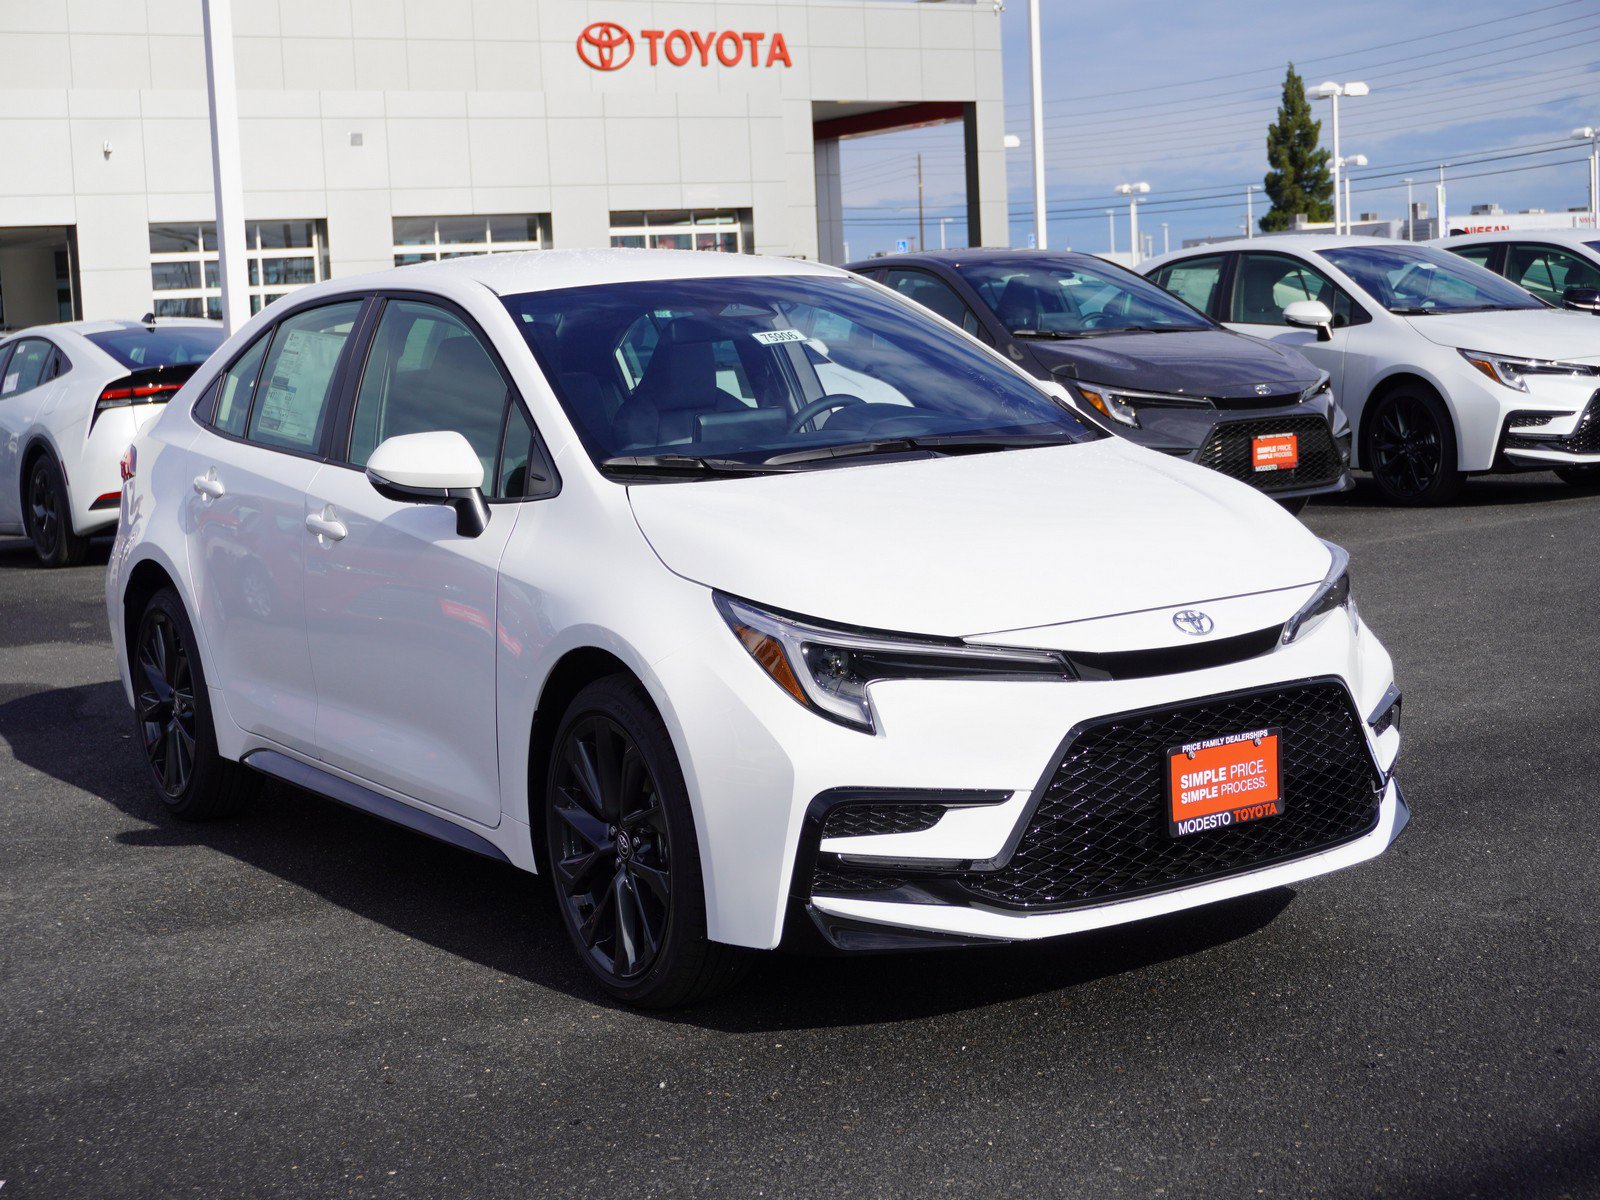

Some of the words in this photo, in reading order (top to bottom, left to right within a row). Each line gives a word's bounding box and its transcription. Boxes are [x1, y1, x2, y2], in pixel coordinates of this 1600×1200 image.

[641, 29, 792, 67] TOYOTA
[760, 331, 799, 342] 75906
[1182, 742, 1201, 753] PRICE
[1202, 738, 1225, 748] FAMILY
[1225, 729, 1268, 744] DEALERSHIPS
[1180, 767, 1226, 789] SIMPLE
[1230, 759, 1267, 779] PRICE.
[1181, 786, 1218, 804] SIMPLE
[1221, 776, 1268, 796] PROCESS.
[1178, 812, 1231, 835] MODESTO
[1233, 802, 1278, 822] TOYOTA
